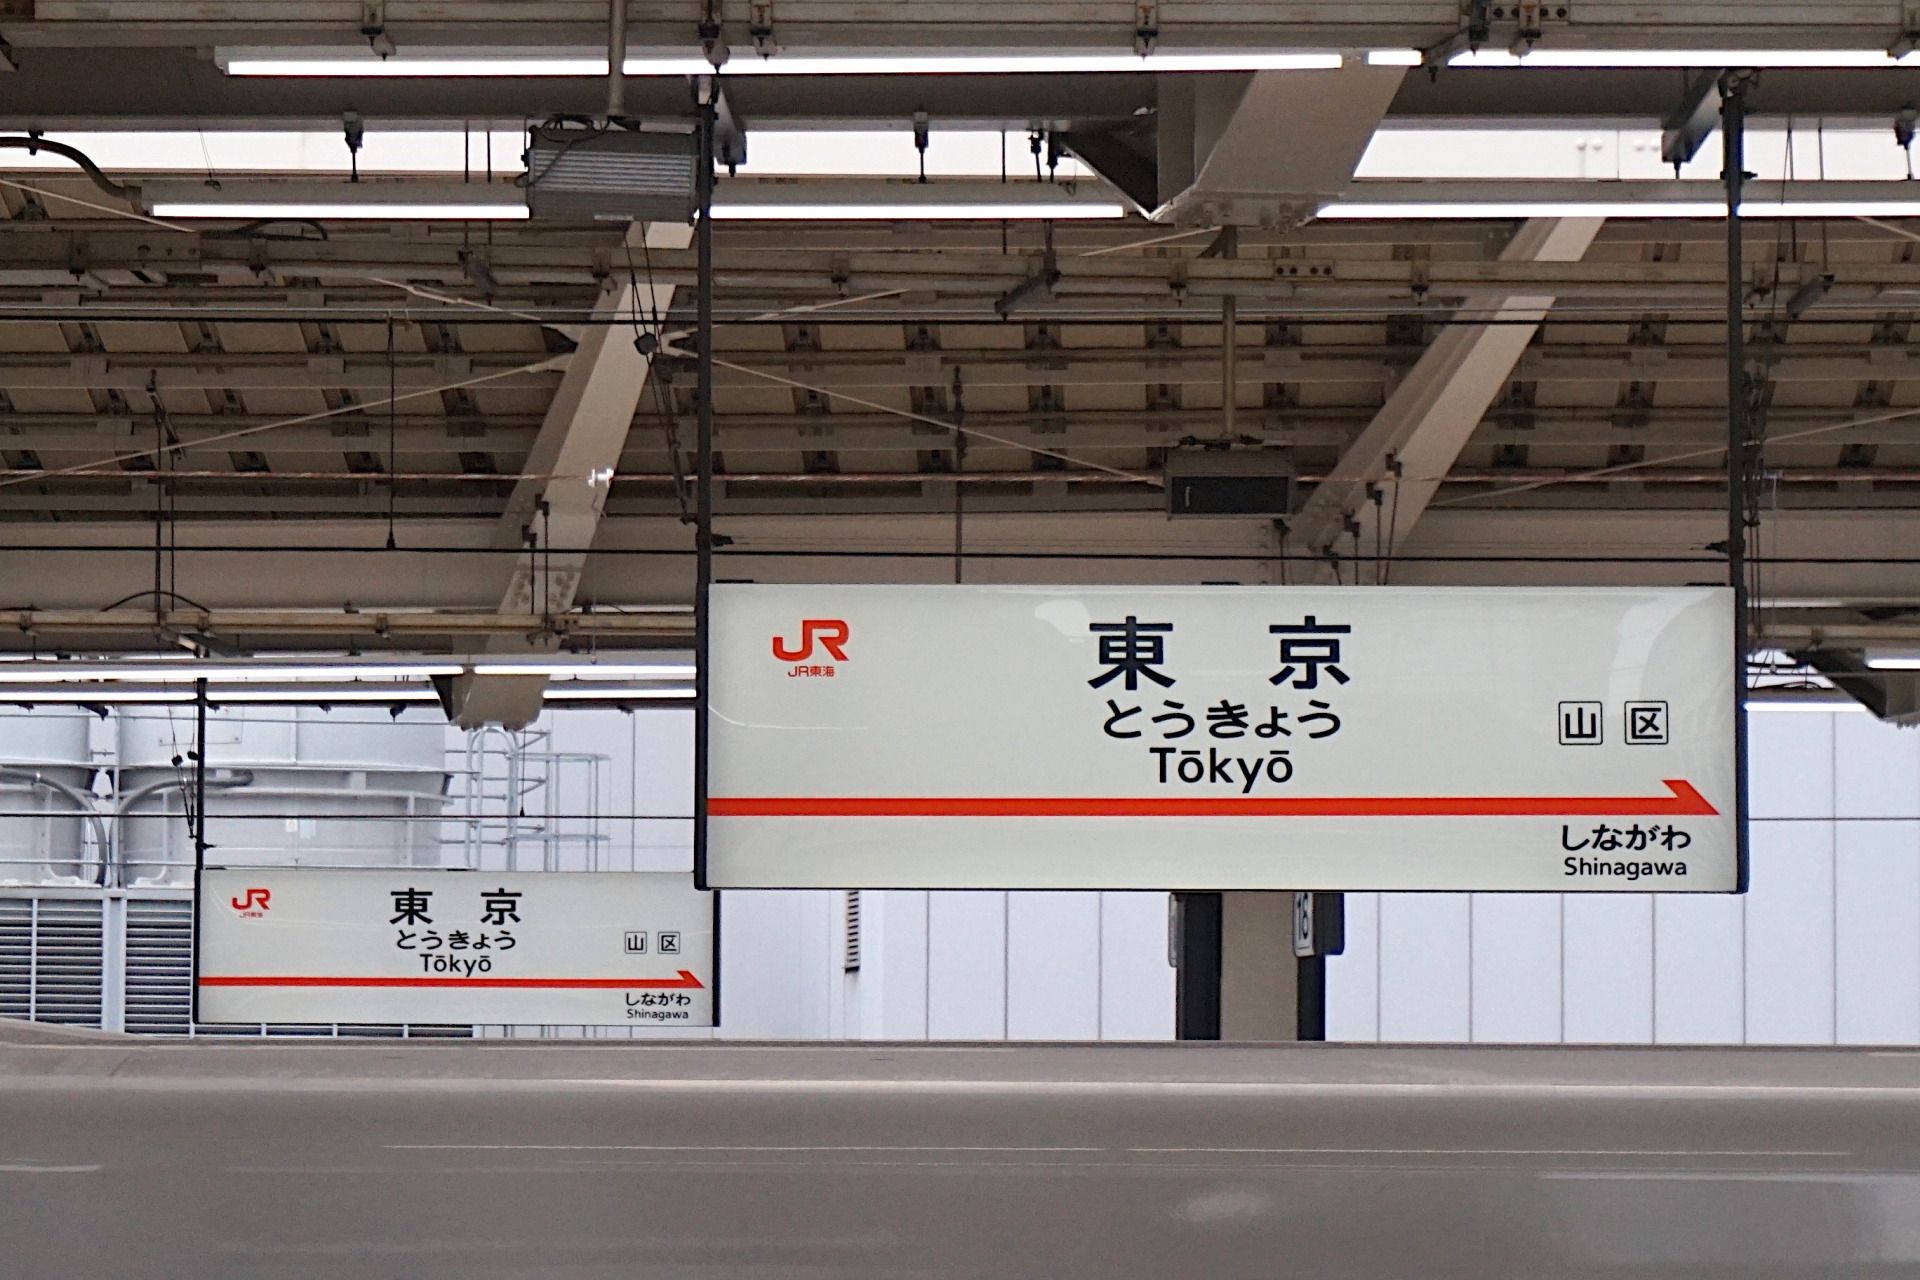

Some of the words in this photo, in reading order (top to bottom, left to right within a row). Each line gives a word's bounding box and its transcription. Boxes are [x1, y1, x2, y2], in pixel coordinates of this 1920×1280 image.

[772, 619, 849, 661] JR
[1087, 615, 1351, 690] 東京
[787, 665, 835, 678] JR東海
[1103, 698, 1343, 738] とうきょう
[1562, 704, 1599, 741] 山
[1628, 704, 1666, 742] 区
[1149, 747, 1293, 794] Tōkyō
[1562, 824, 1692, 851] しながわ
[1564, 856, 1687, 881] Shinagawa
[232, 889, 271, 910] JR
[389, 887, 522, 925] 東京
[396, 930, 516, 950] とうきょう
[627, 933, 645, 952] 山
[659, 933, 678, 952] 区
[420, 953, 492, 977] Tōkyō
[625, 992, 692, 1007] しながわ
[626, 1008, 689, 1021] Shinagawa
